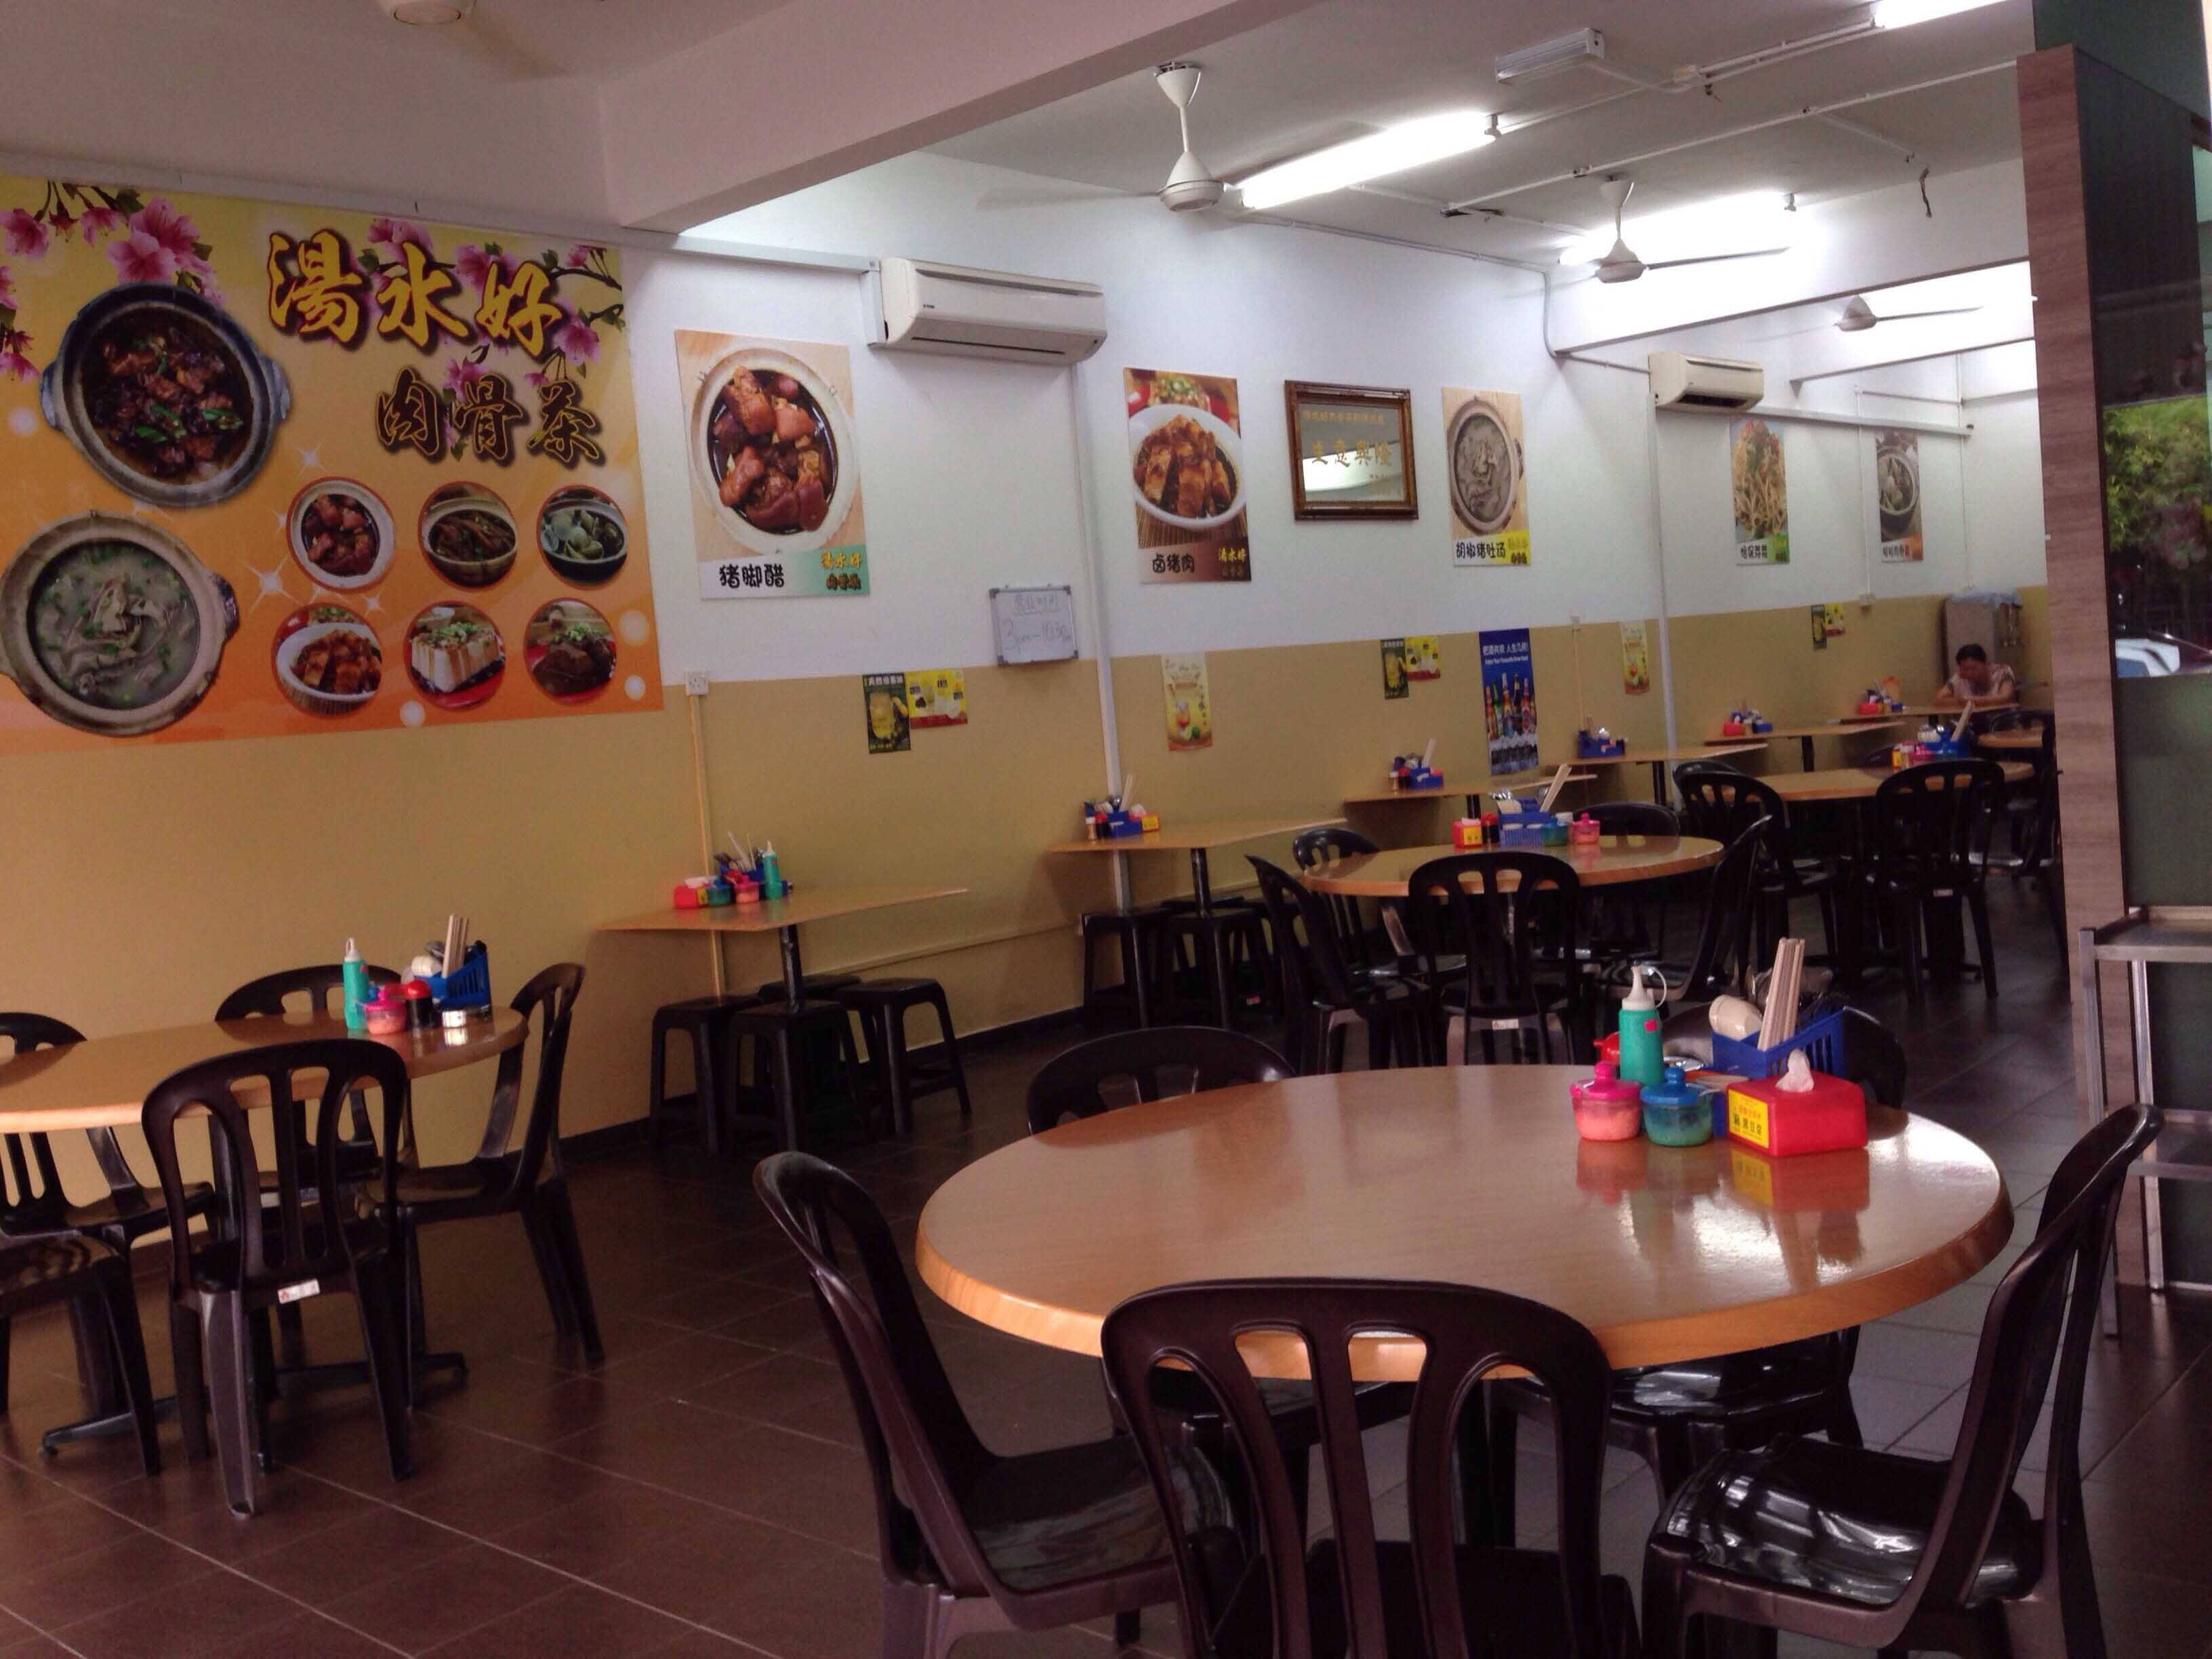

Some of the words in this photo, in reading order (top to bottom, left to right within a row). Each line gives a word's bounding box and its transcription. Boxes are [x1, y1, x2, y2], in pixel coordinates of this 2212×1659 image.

[267, 228, 562, 358] 湯水好
[375, 367, 601, 464] 肉骨茶
[719, 563, 784, 588] 猪脚醋
